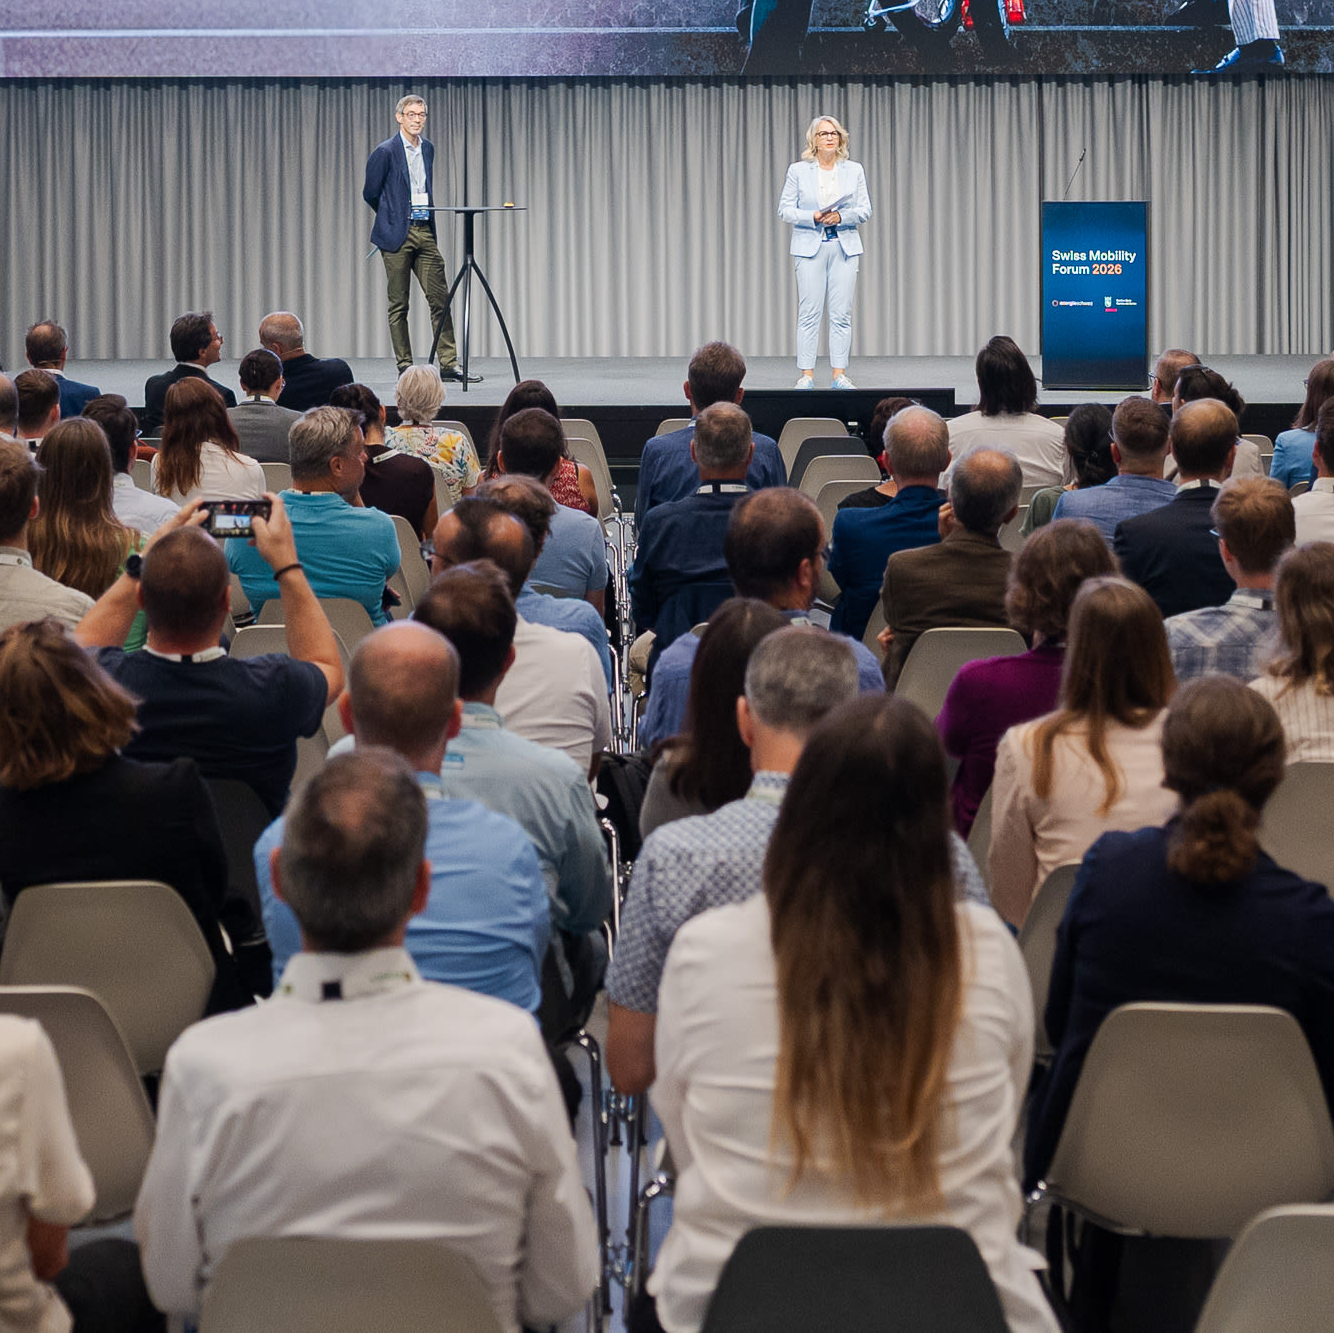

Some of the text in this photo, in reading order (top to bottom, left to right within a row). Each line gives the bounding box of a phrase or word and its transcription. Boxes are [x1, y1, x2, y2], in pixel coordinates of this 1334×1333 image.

[1052, 250, 1136, 263] Swiss Mobility
[1052, 263, 1123, 275] Forum 2026
